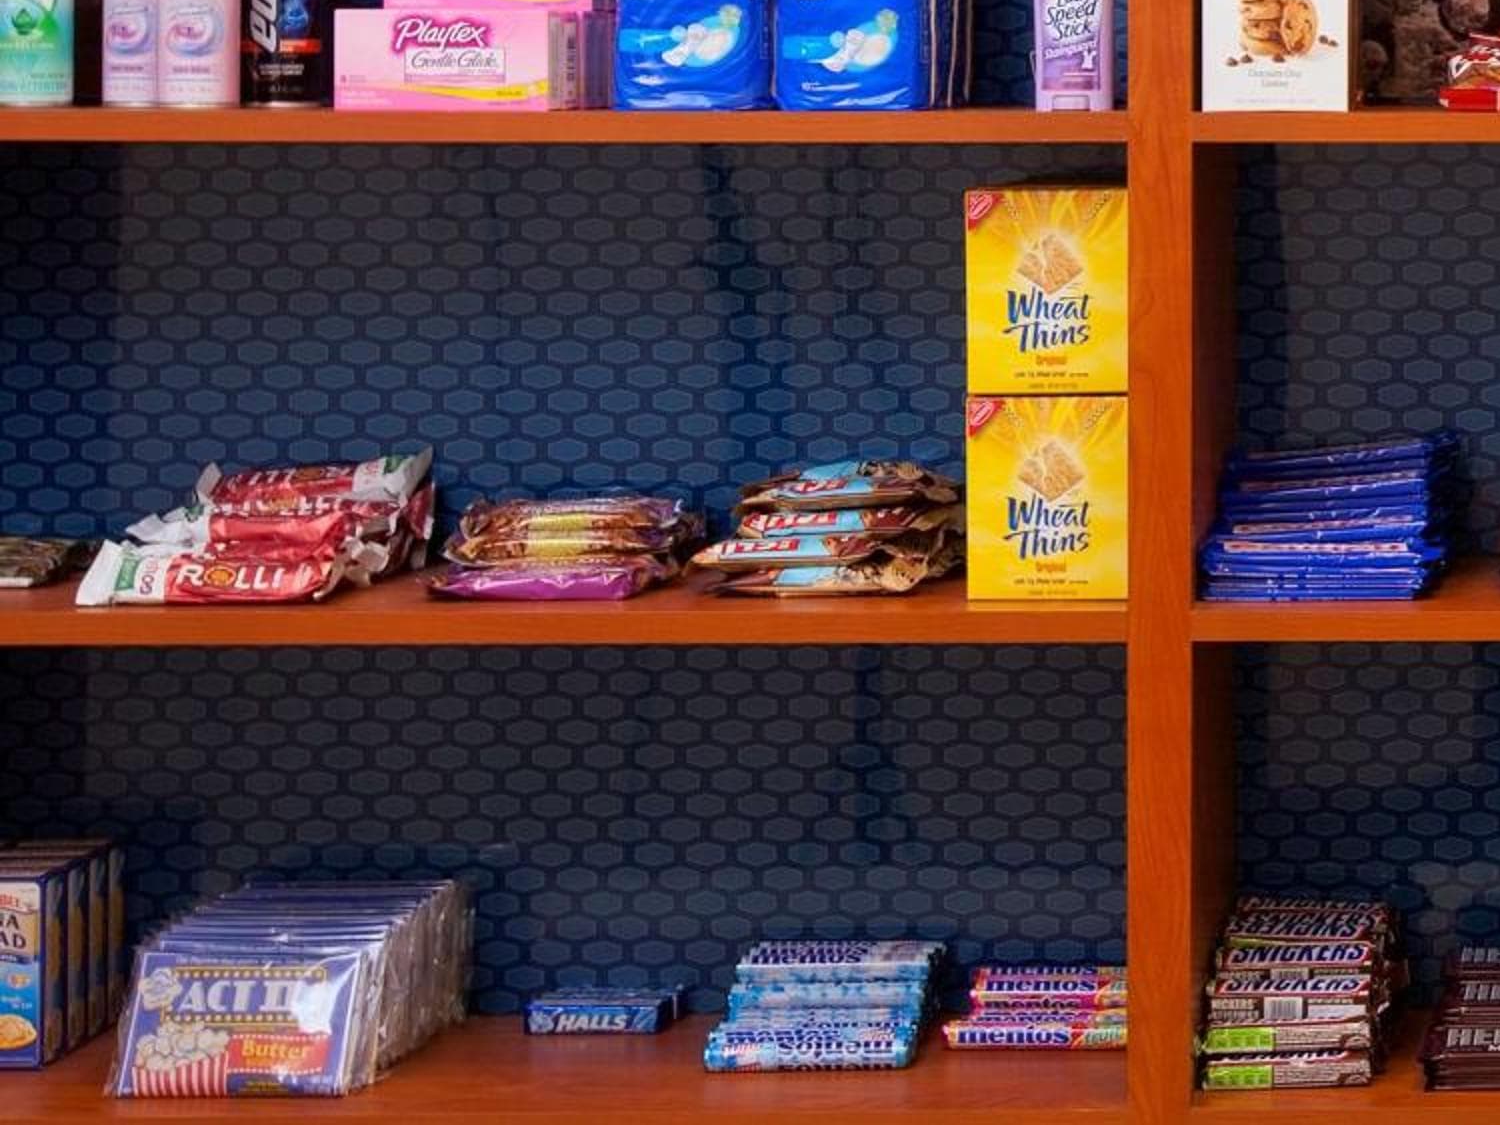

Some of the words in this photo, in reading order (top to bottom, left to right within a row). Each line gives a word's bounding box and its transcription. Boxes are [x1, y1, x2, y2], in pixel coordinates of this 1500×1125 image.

[394, 17, 486, 51] Playtex
[1053, 20, 1092, 41] Stick
[411, 50, 456, 69] Gentle
[456, 50, 500, 68] Glide
[1006, 289, 1092, 324] Wheat
[1003, 322, 1091, 355] Thins
[1006, 496, 1092, 531] Wheat
[1003, 529, 1091, 561] Thins
[1231, 945, 1365, 964] SNICKERS
[985, 978, 1097, 992] mentos
[180, 979, 260, 1013] ACT
[258, 979, 295, 1012] II
[553, 1013, 629, 1032] HALLS
[957, 1024, 1071, 1044] mentos
[240, 1039, 312, 1061] Butter
[776, 1040, 893, 1059] mentos
